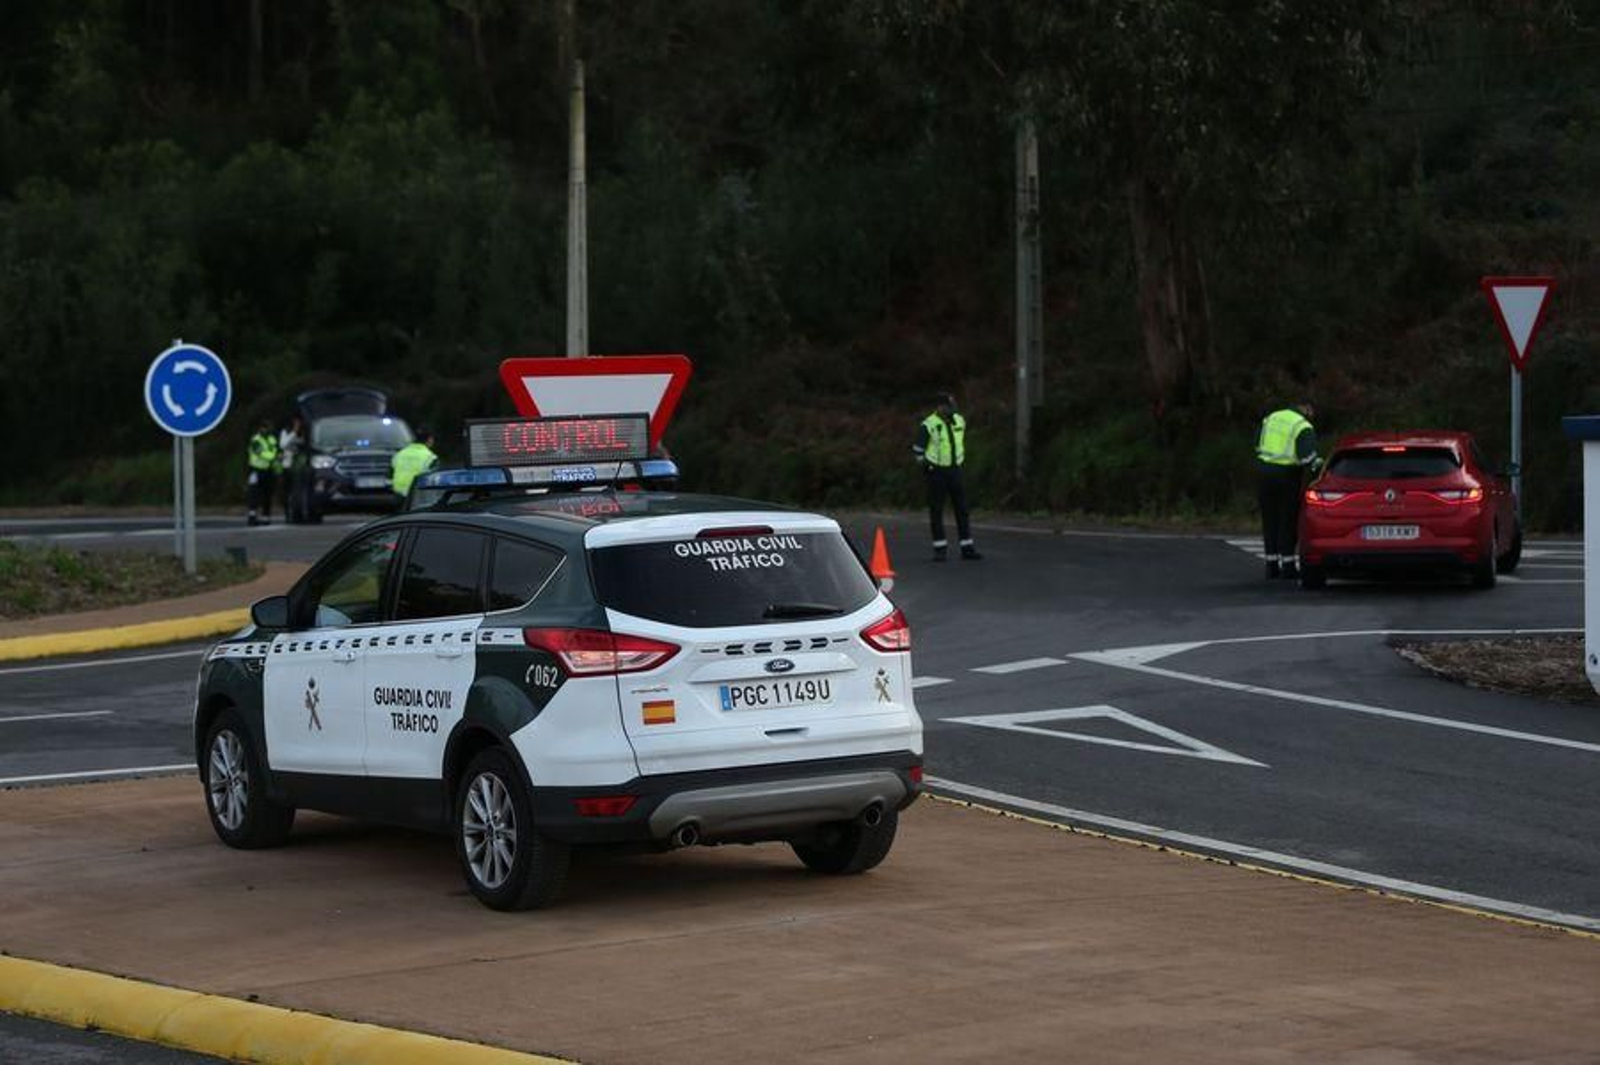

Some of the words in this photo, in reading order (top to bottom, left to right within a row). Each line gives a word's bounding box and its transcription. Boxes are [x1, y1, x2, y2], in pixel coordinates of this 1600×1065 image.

[504, 420, 629, 453] CONTROL
[674, 538, 755, 556] GUARDIA
[757, 535, 803, 551] CIVIL
[706, 553, 784, 571] TRÁFICO
[535, 664, 558, 688] 062
[373, 687, 424, 707] GUARDIA
[425, 689, 452, 709] CIVIL
[731, 684, 769, 708] PGC
[390, 709, 439, 734] TRÁFICO
